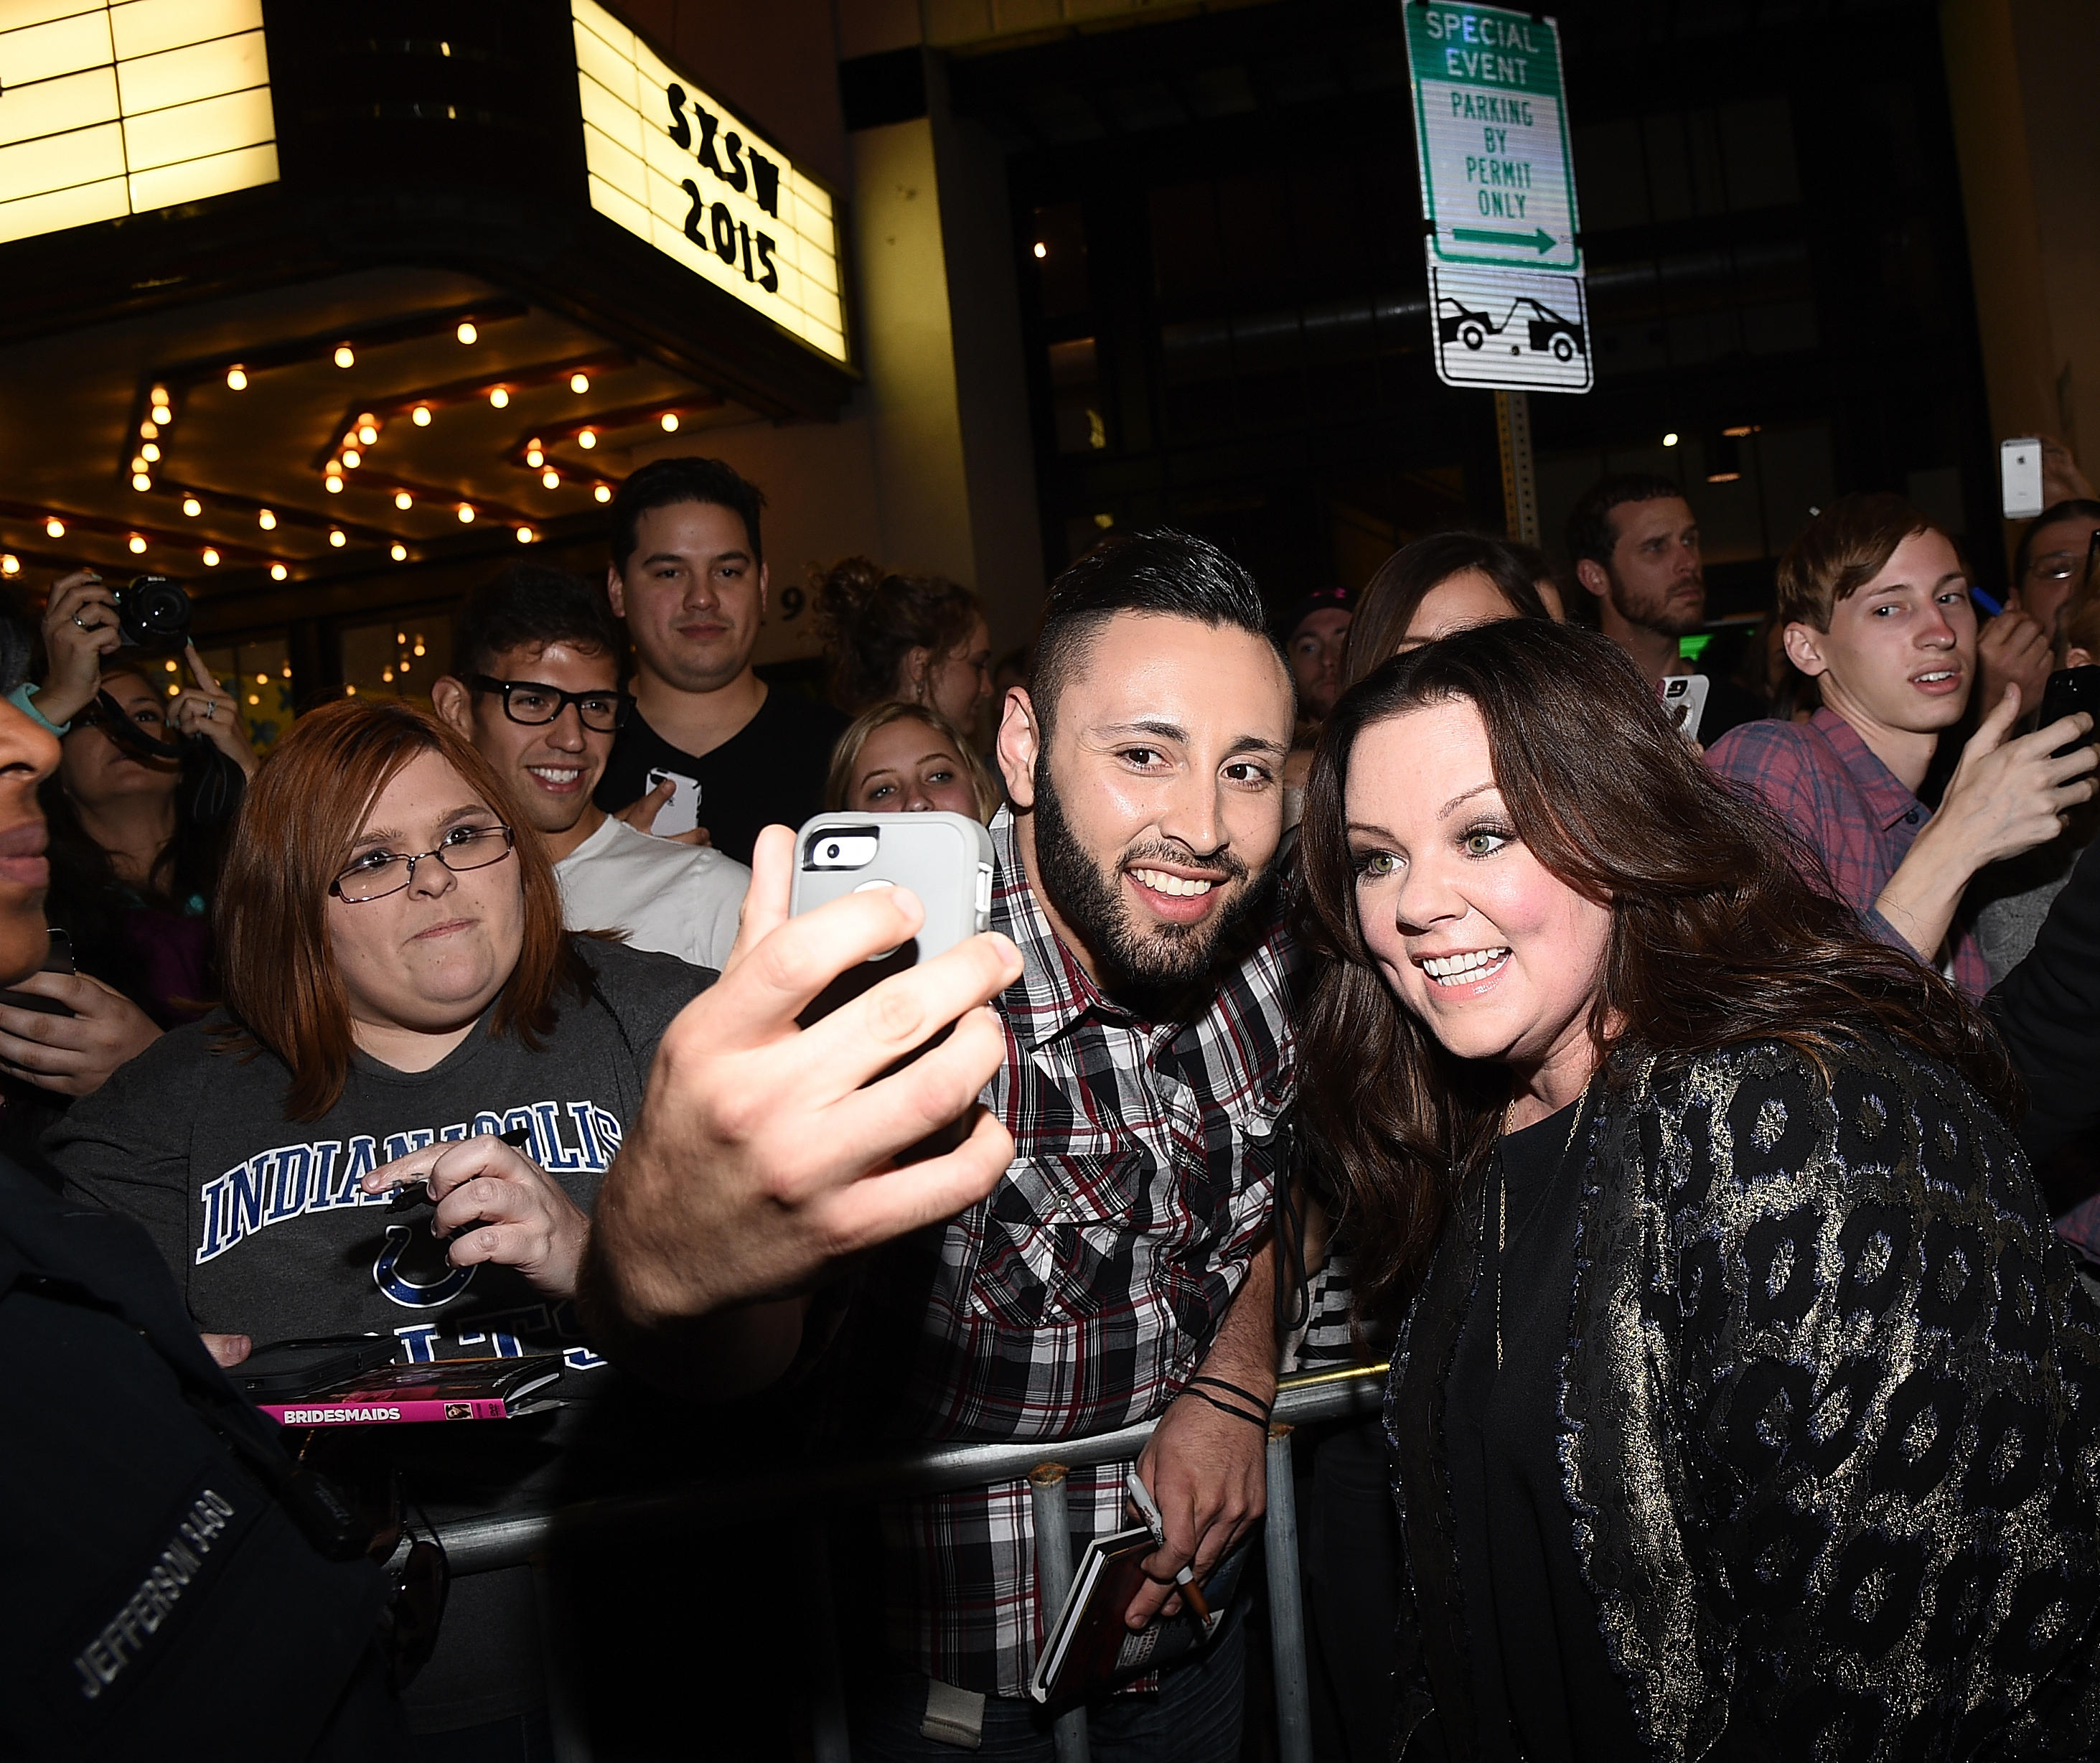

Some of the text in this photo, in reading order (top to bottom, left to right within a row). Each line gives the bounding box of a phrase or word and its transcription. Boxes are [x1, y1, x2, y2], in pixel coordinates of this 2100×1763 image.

[1425, 10, 1539, 53] SPECIAL
[1445, 47, 1528, 85] EVENT
[1450, 91, 1534, 127] PARKING
[667, 83, 780, 220] SXSW
[1483, 126, 1506, 155] BY
[1466, 156, 1532, 190] PERMIT
[1478, 190, 1527, 220] ONLY
[680, 178, 779, 294] 2015
[283, 1407, 401, 1425] BRIDESMAIDS
[74, 1537, 202, 1699] JEFFERSON
